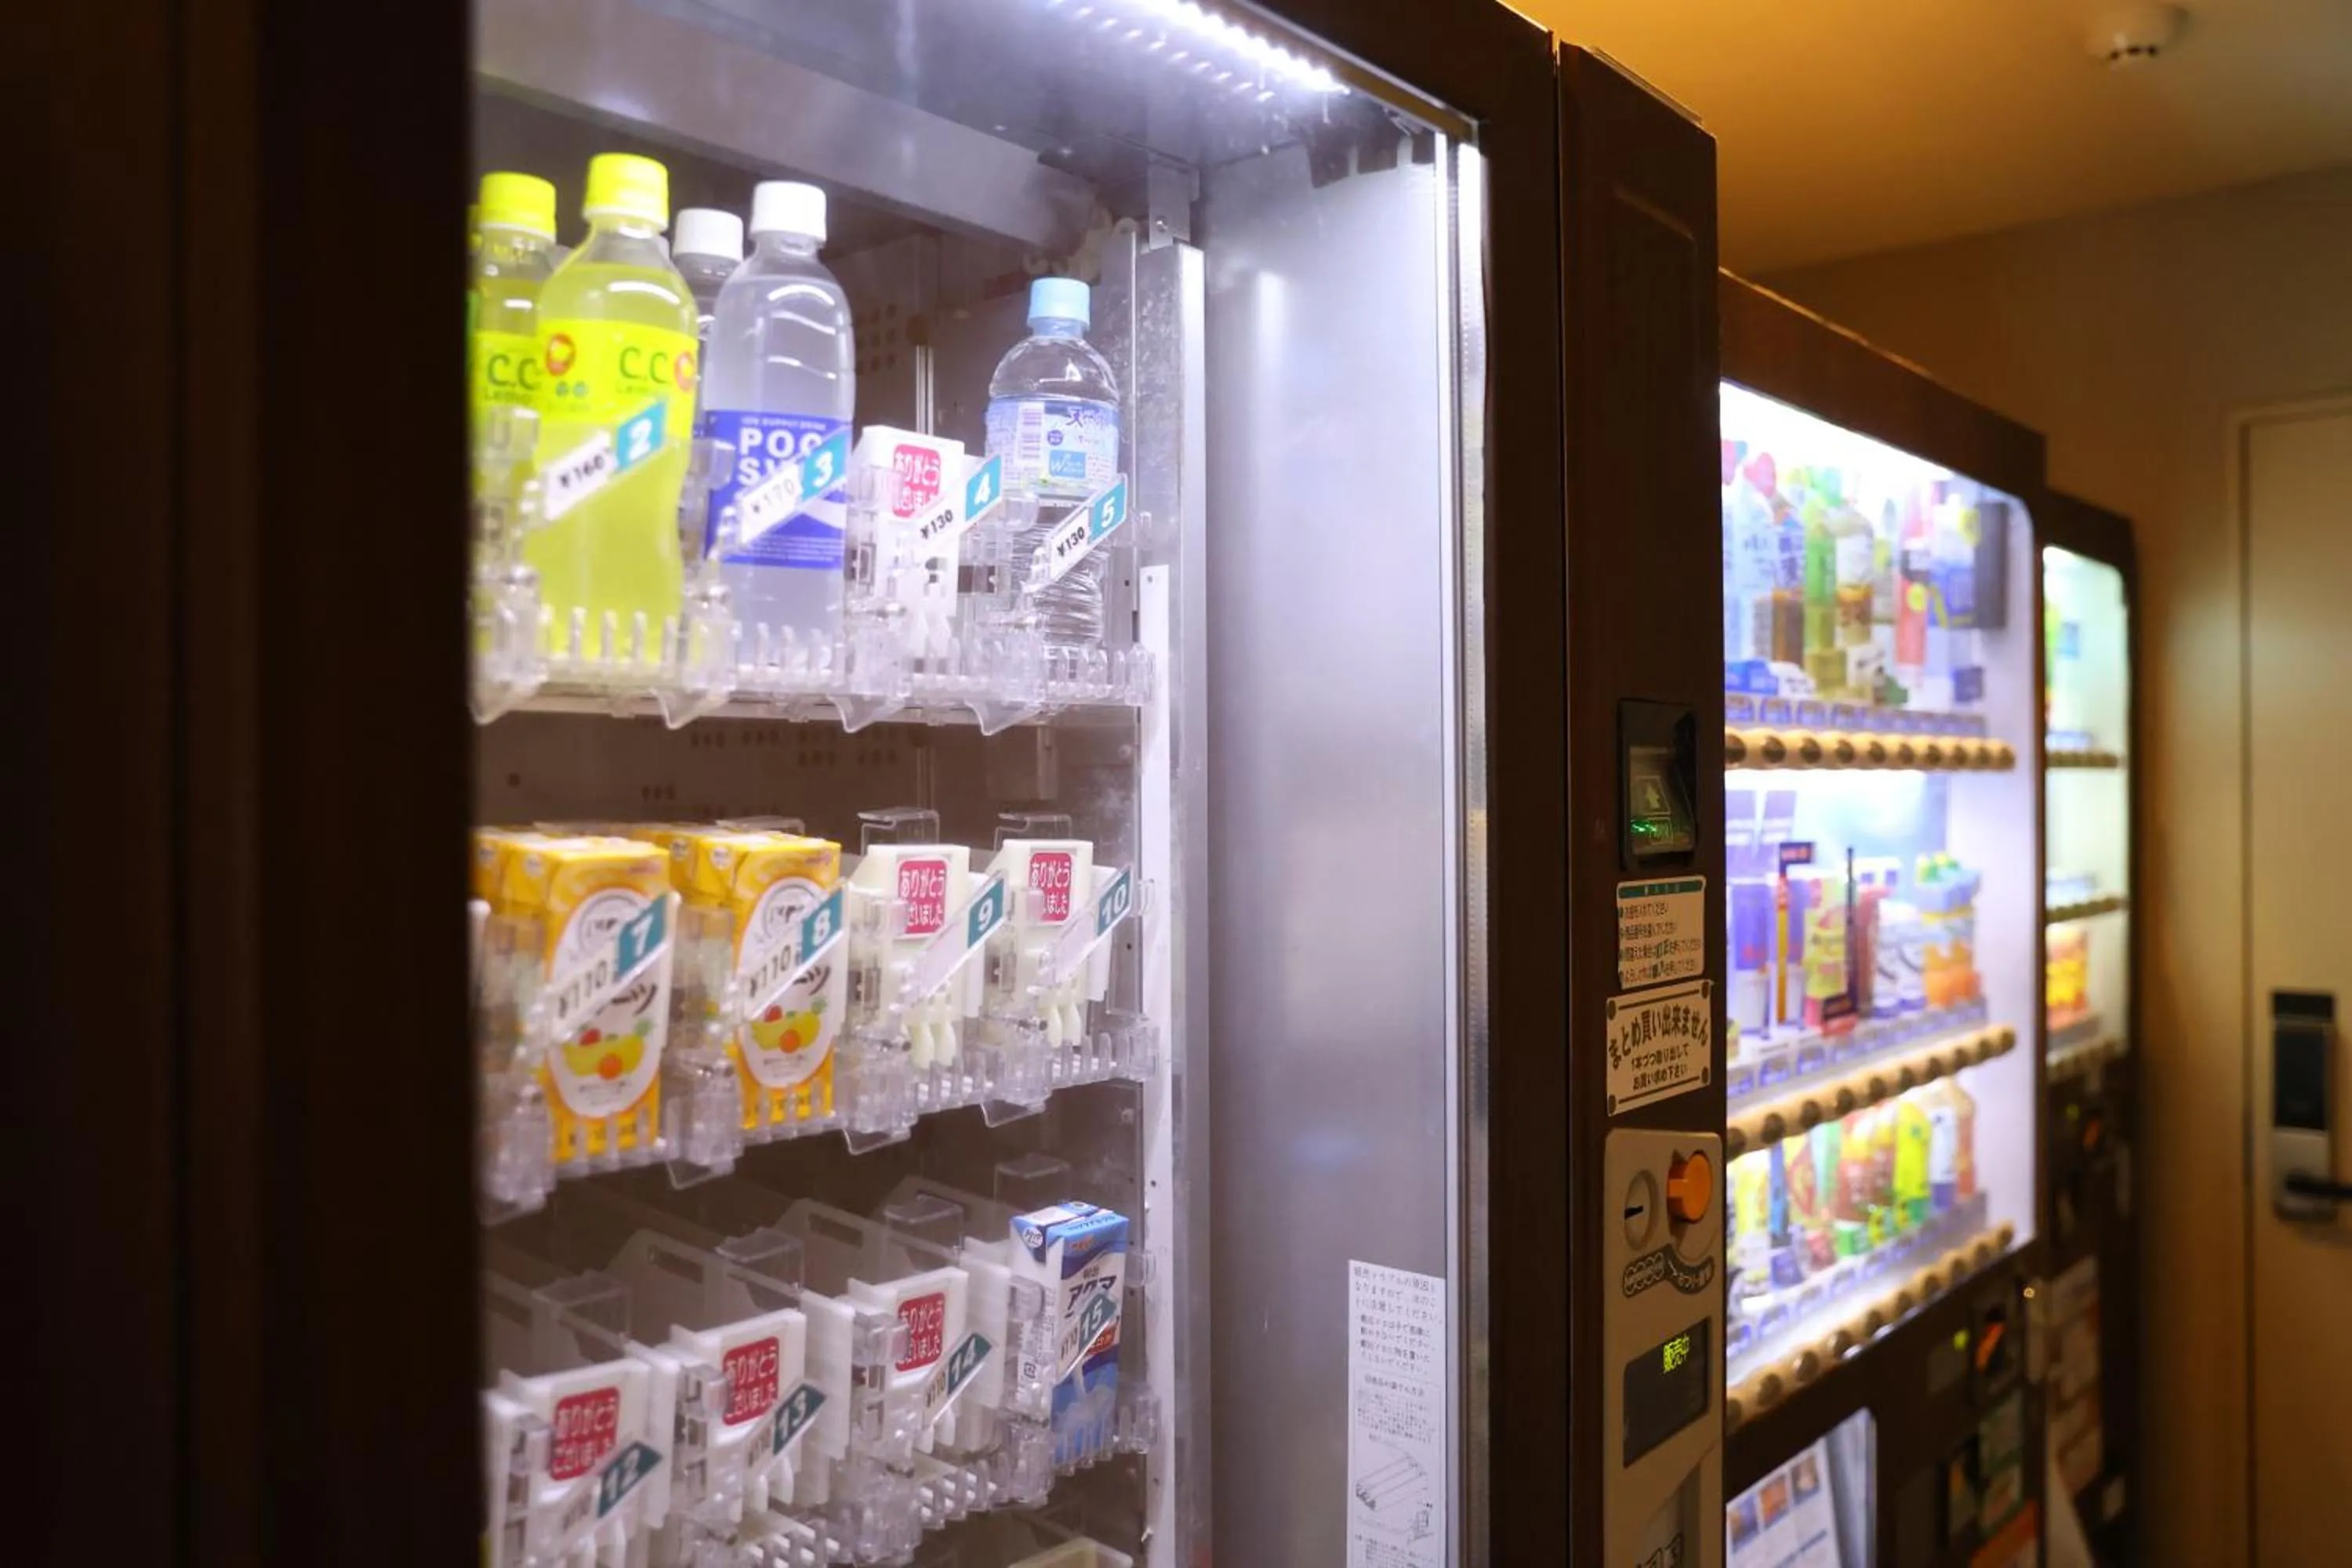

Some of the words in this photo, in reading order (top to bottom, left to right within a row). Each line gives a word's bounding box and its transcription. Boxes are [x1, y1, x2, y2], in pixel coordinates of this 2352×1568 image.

[628, 419, 652, 461] 2
[812, 450, 833, 488] 3
[974, 471, 991, 506] 4
[920, 509, 953, 539] ¥130
[1102, 496, 1115, 528] 5
[1056, 526, 1085, 557] ¥130
[978, 897, 993, 931] 9
[1102, 883, 1127, 925] 10
[630, 913, 654, 957] 7
[812, 907, 831, 946] 8
[1608, 1004, 1708, 1072] まとめ買い出来ません
[1083, 1298, 1103, 1341] 15
[950, 1336, 977, 1383] 14
[779, 1389, 808, 1441] 13
[606, 1449, 641, 1501] 12
